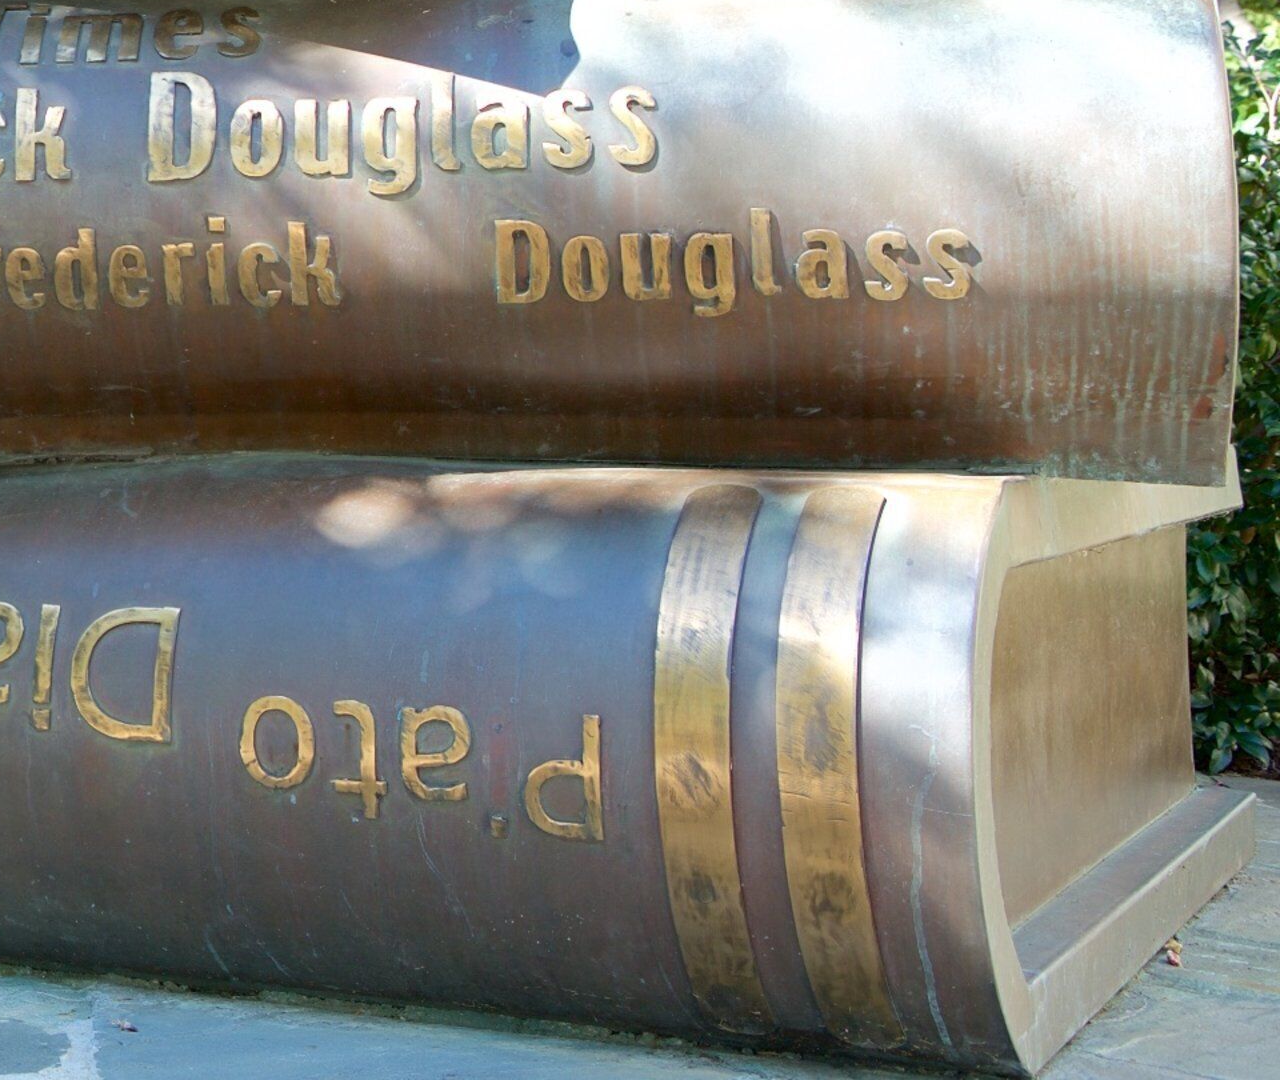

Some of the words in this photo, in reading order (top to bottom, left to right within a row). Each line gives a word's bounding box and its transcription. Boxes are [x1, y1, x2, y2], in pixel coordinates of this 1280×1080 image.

[146, 70, 660, 198] Douglass
[494, 207, 976, 319] Douglass
[237, 692, 606, 843] Pato
